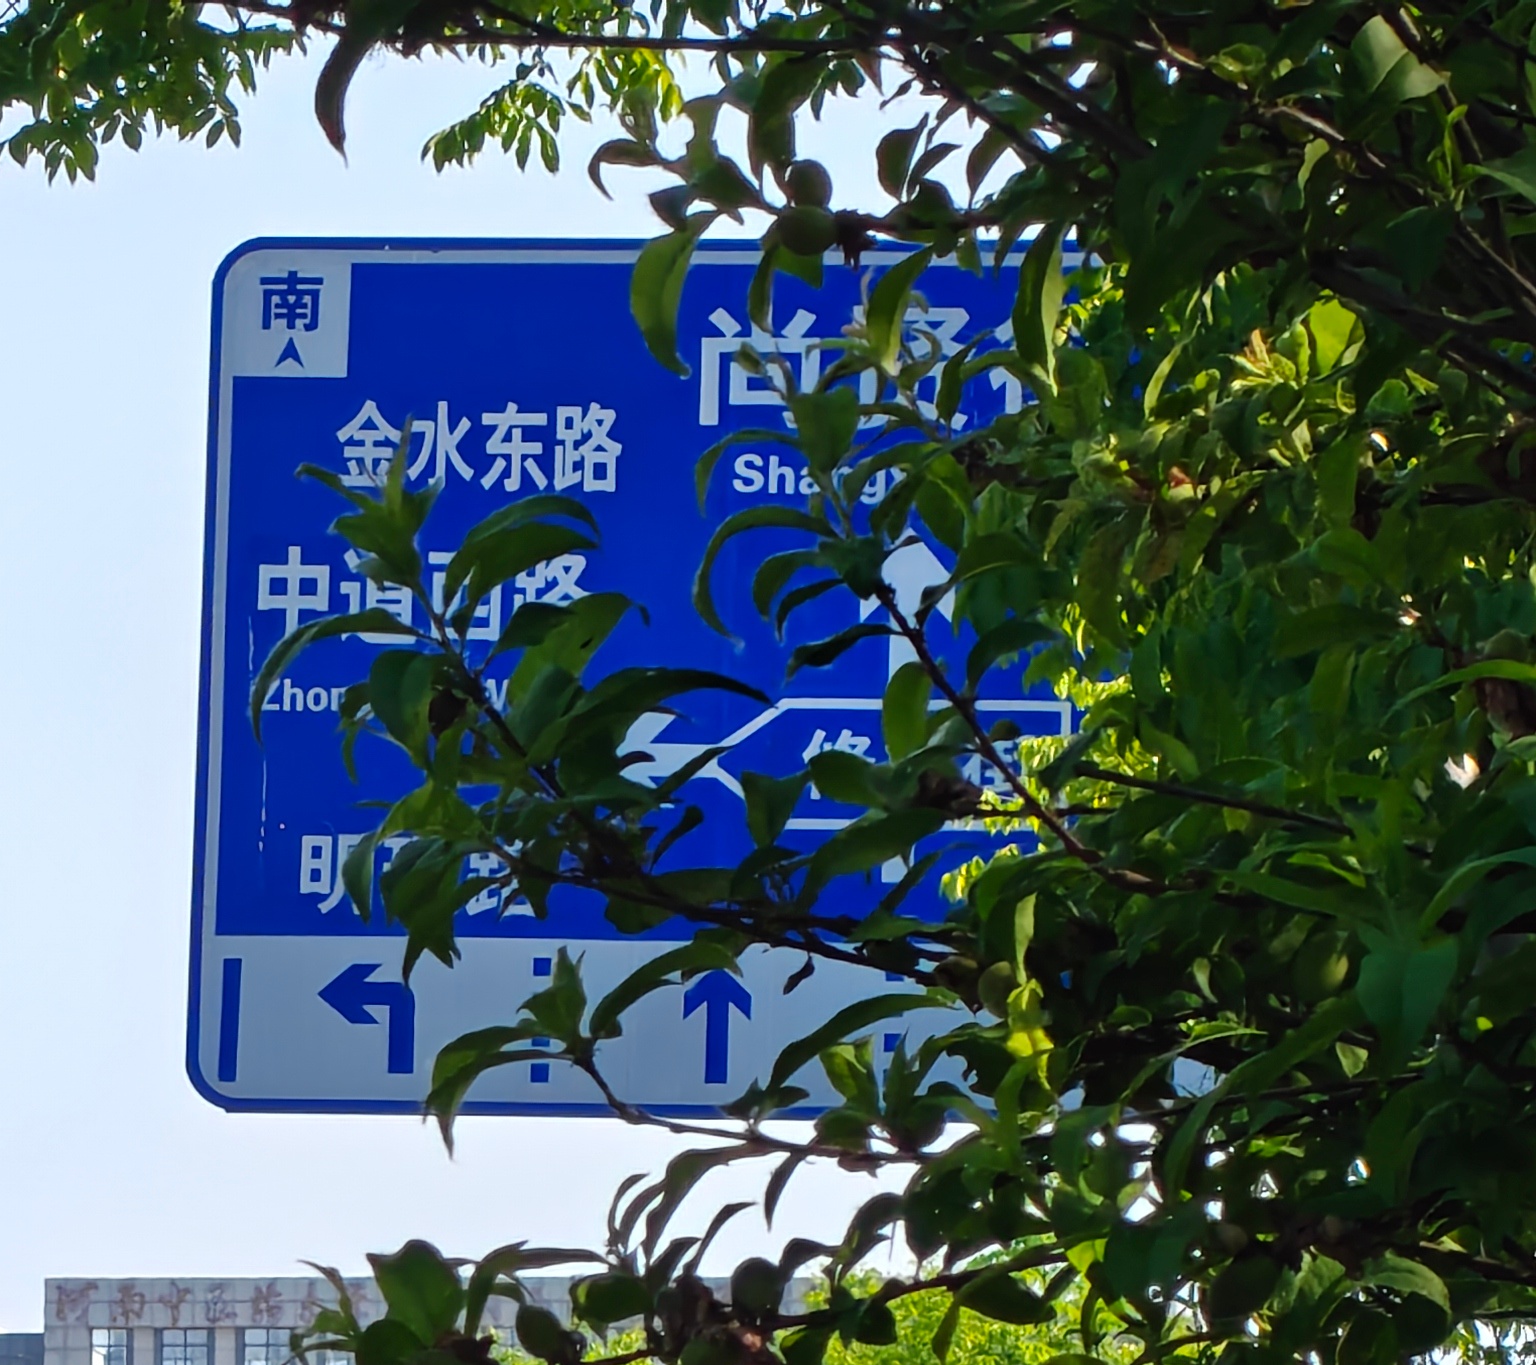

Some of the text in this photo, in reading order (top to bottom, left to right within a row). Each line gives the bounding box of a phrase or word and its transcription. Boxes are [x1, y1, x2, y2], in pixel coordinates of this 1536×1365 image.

[259, 270, 324, 332] 南
[336, 400, 622, 492] 金水东路
